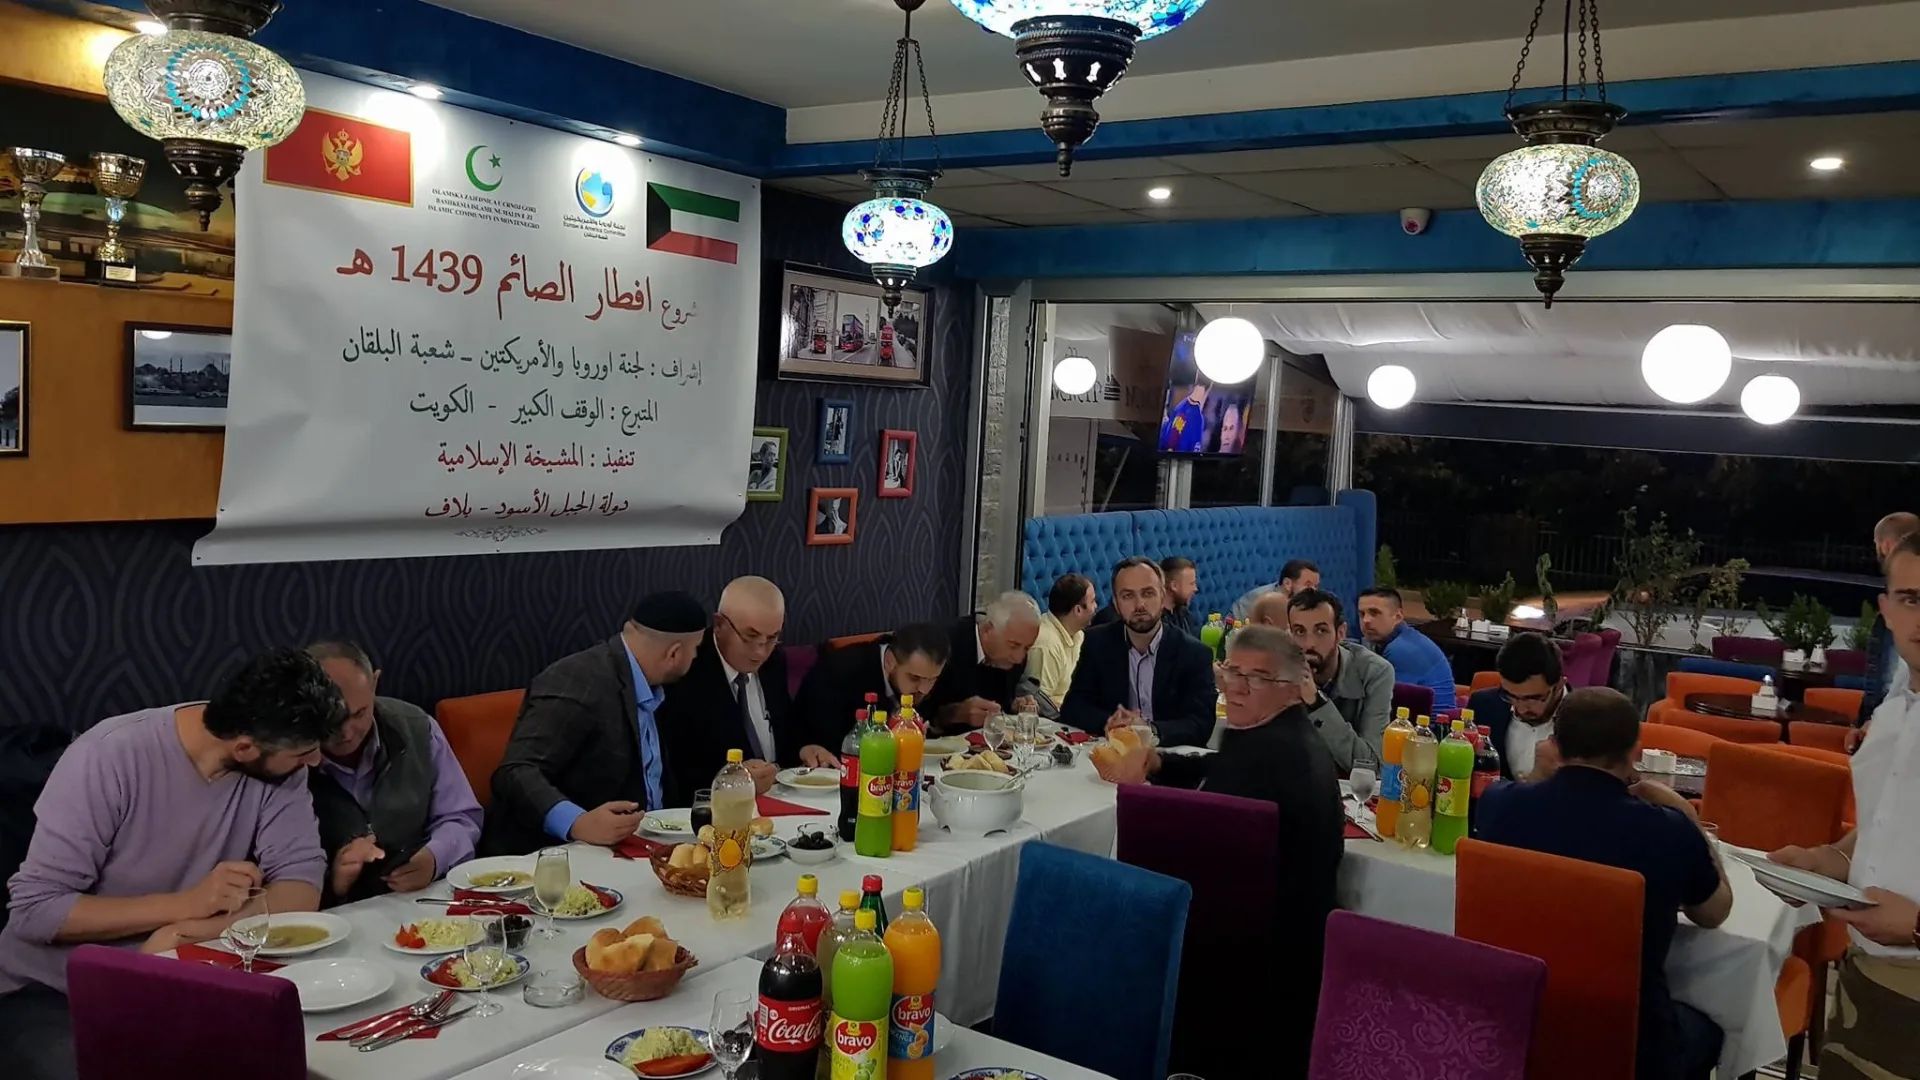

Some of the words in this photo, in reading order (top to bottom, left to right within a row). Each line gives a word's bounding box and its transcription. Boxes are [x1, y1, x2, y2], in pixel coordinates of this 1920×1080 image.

[427, 204, 454, 214] ISLAMIC
[454, 209, 492, 221] COMMUNITY
[500, 217, 540, 230] MONTENEGRO
[391, 245, 483, 295] 1439
[497, 253, 575, 321] الصائم
[342, 326, 402, 363] البلقان
[410, 333, 455, 364] شعبة
[619, 350, 645, 379] لجنة
[409, 383, 474, 422] الكويت
[510, 388, 554, 425] الكبير
[560, 396, 604, 427] الوقف
[621, 399, 658, 436] المتبرع
[438, 440, 517, 475] الإسلامية
[524, 442, 584, 473] المشيخة
[602, 446, 636, 473] تنفيذ
[425, 492, 473, 518] بلاف
[494, 488, 550, 519] الأسود
[550, 489, 596, 517] الجبل
[599, 491, 629, 517] دولة
[870, 782, 891, 791] bravo
[898, 1006, 931, 1021] bravo
[837, 1029, 872, 1046] bravo
